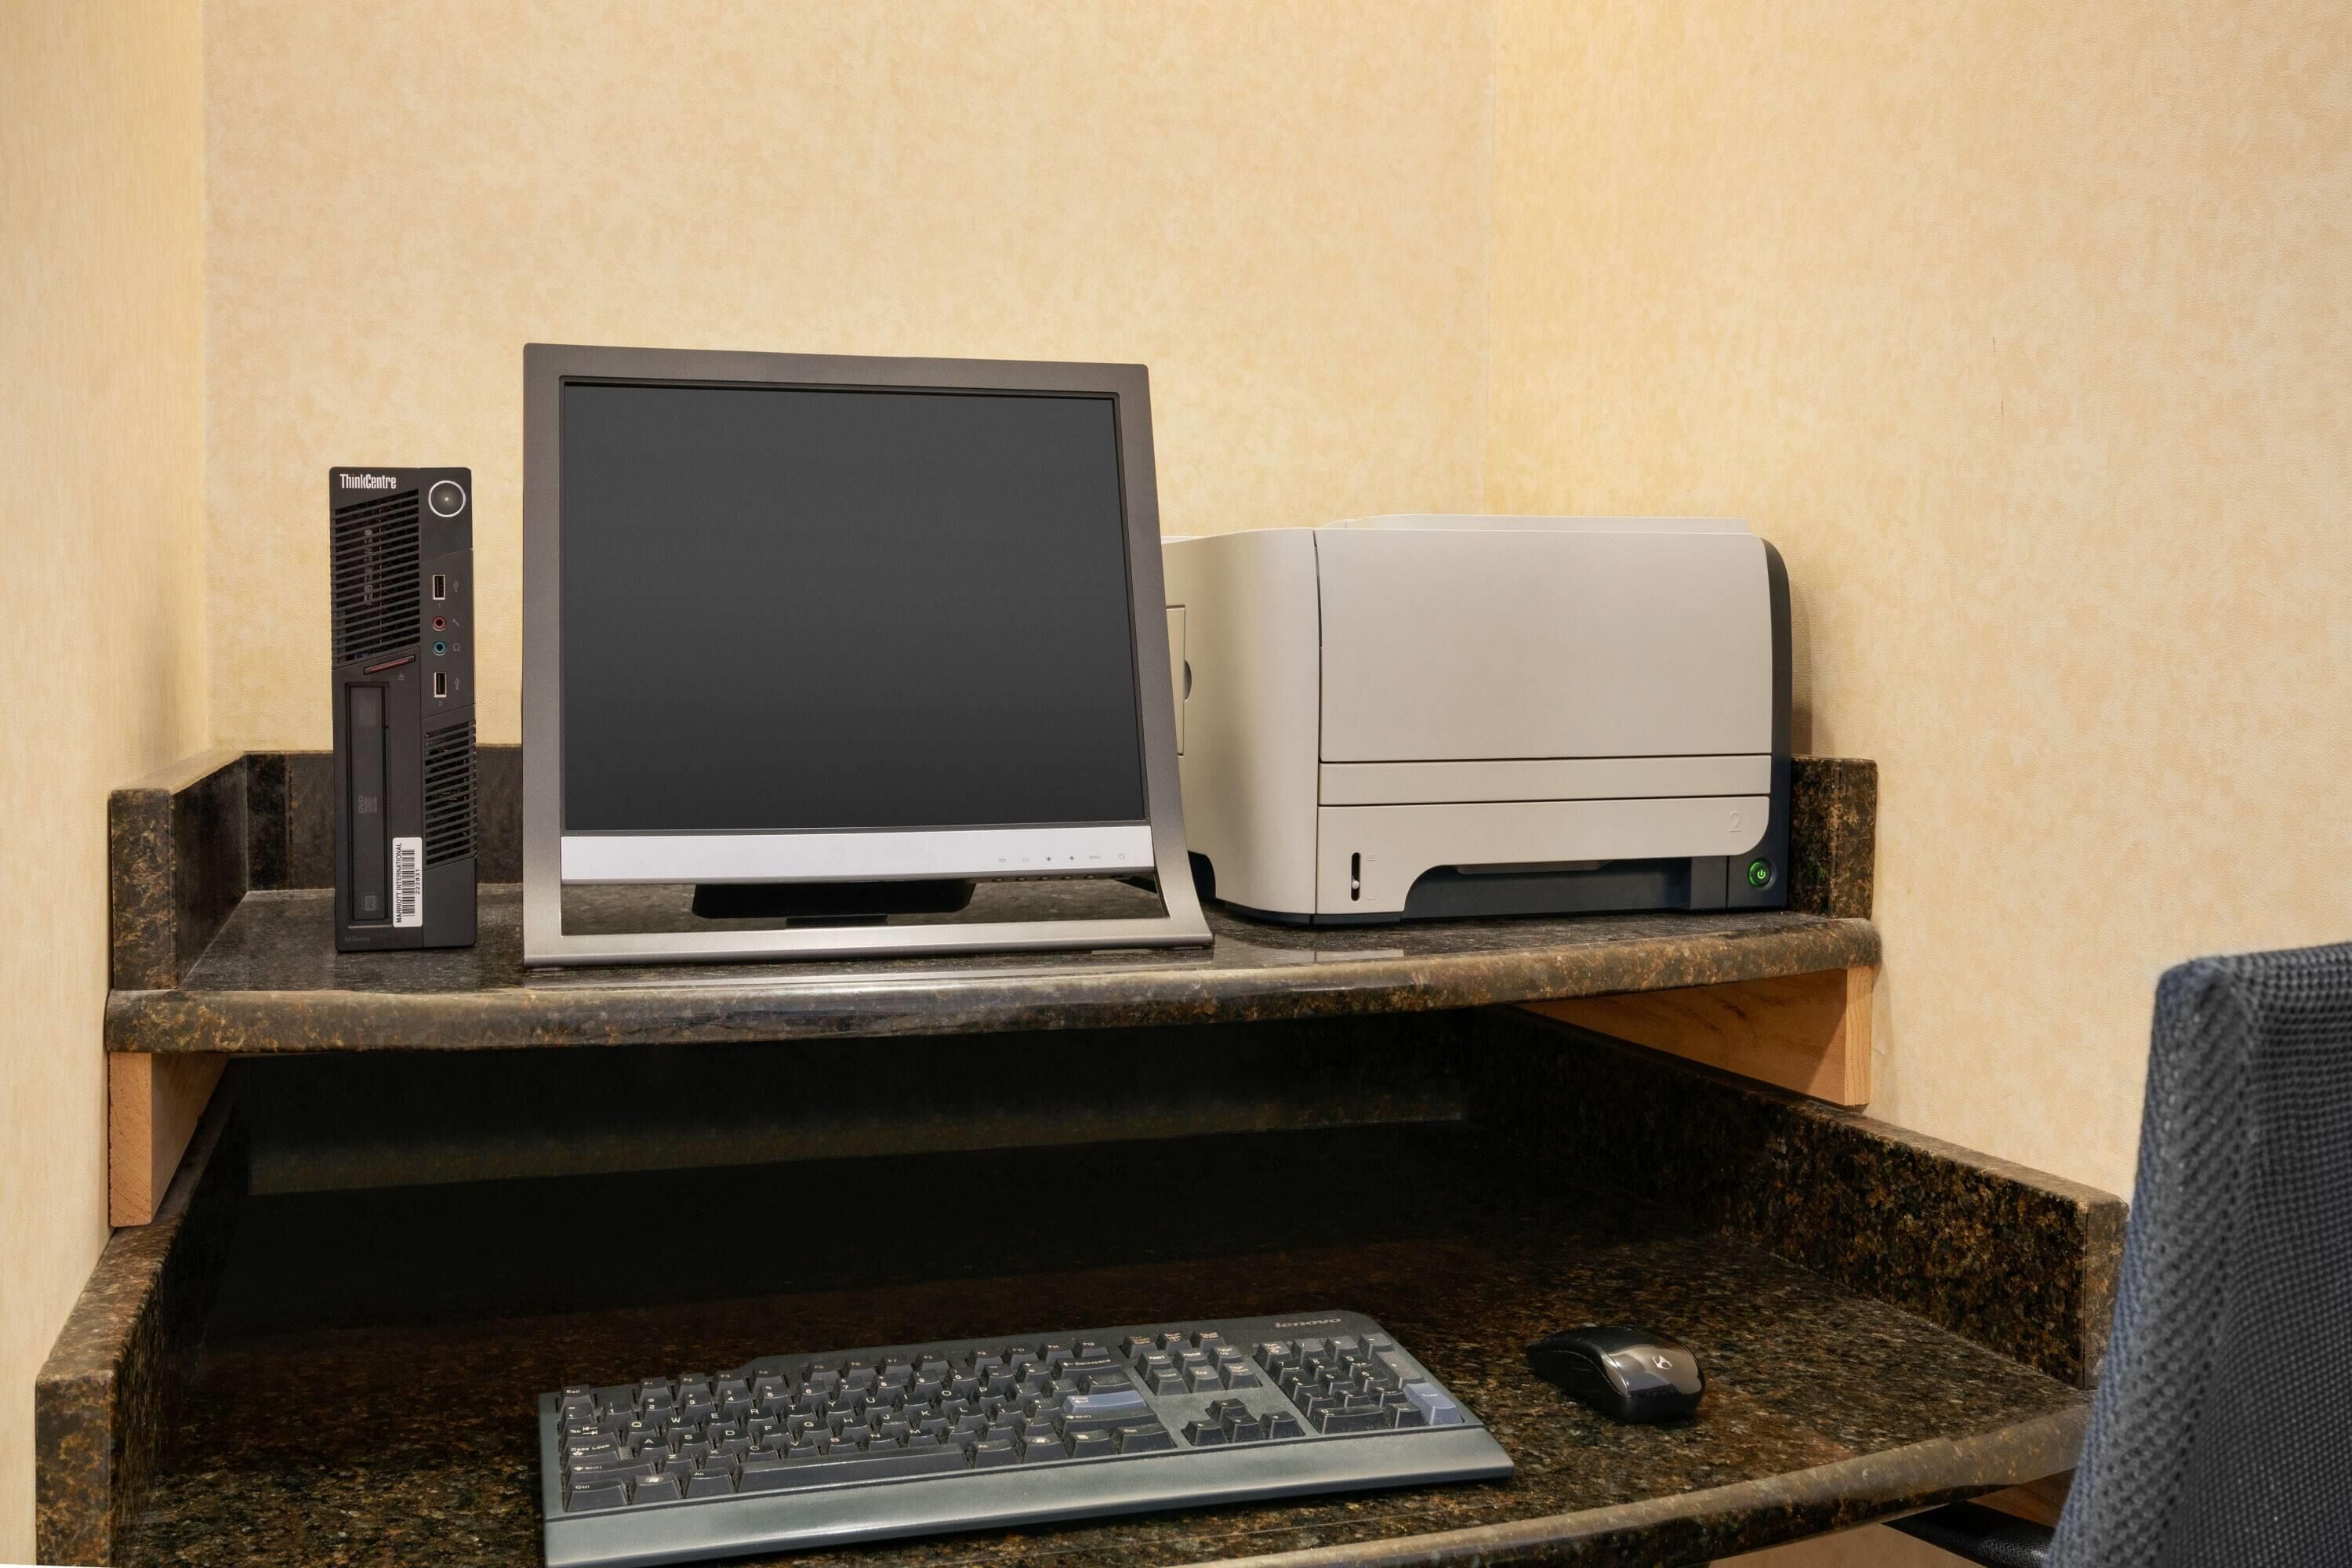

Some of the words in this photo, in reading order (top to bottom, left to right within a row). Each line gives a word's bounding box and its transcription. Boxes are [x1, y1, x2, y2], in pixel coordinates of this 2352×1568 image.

[339, 474, 397, 489] ThinkCentre
[1730, 811, 1744, 833] 2
[1276, 1318, 1341, 1327] lenovo
